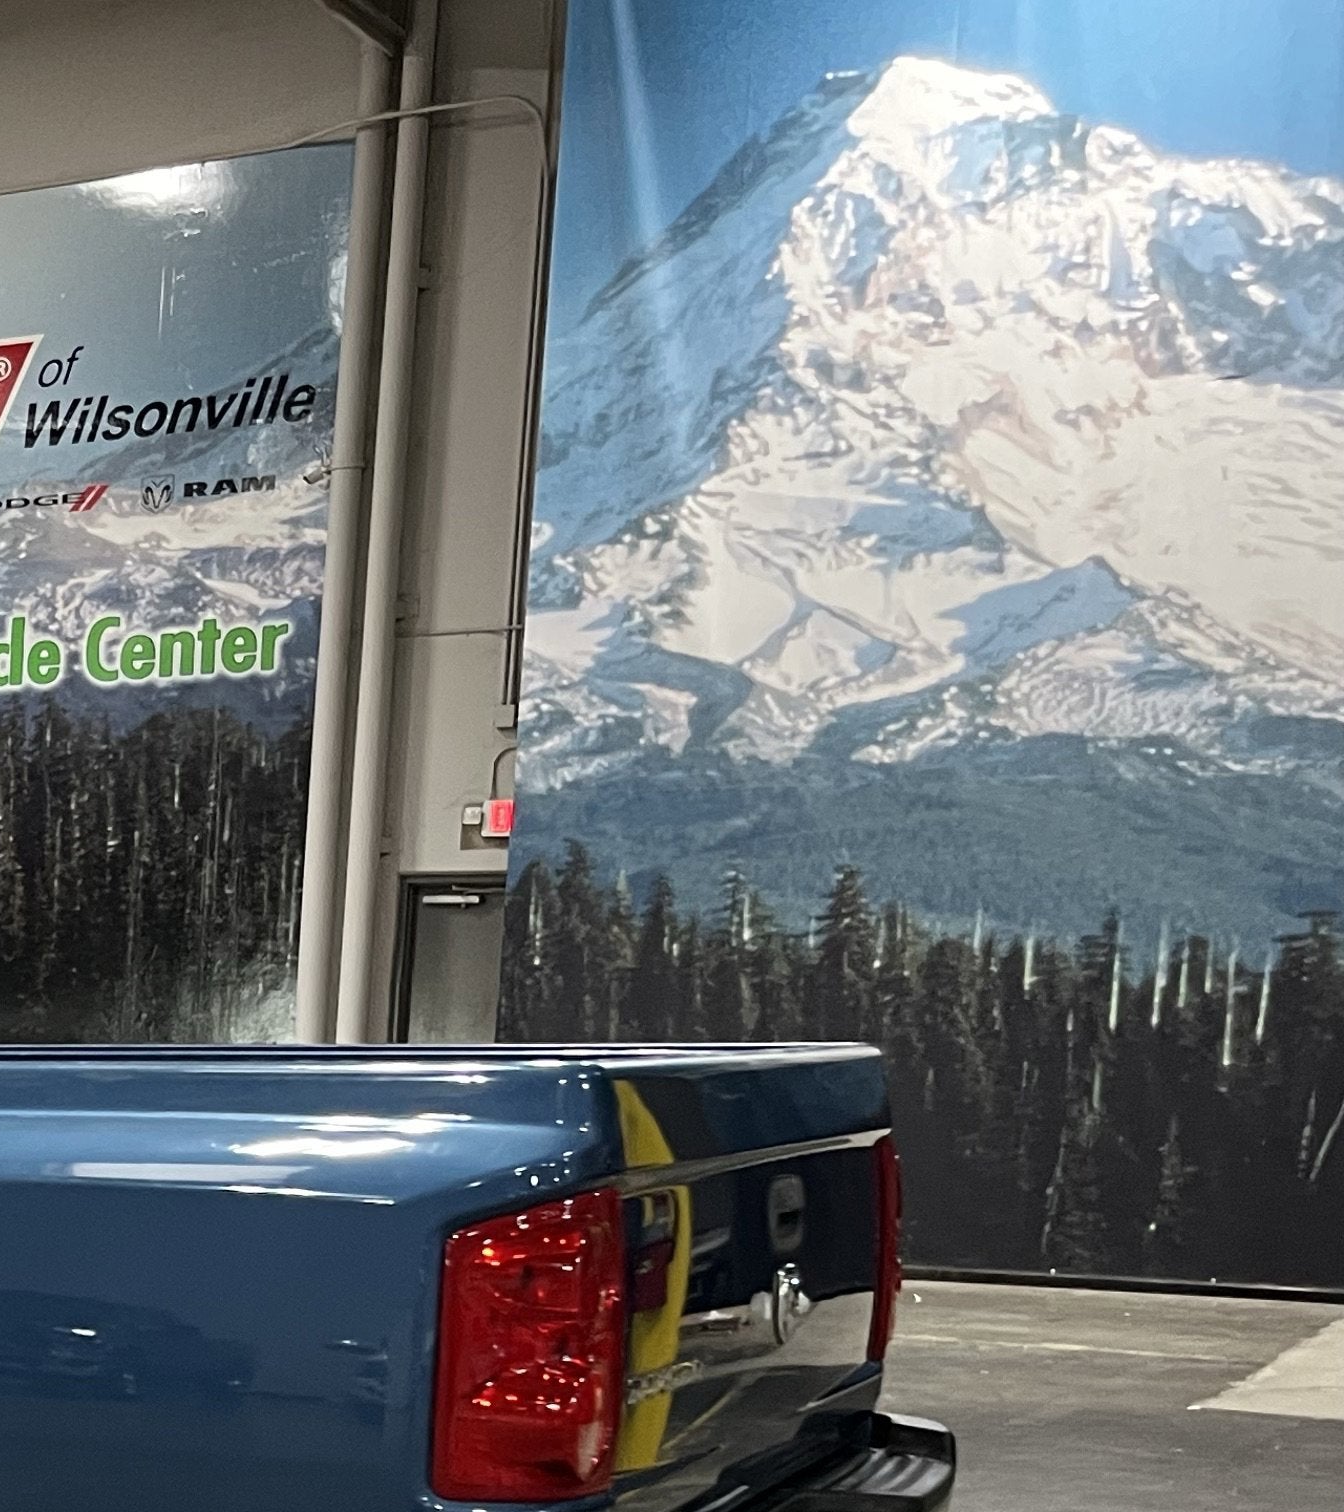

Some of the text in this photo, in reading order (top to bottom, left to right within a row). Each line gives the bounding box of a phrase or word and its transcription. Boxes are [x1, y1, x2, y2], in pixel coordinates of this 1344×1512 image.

[38, 346, 85, 388] of
[24, 374, 316, 449] Wilsonville
[183, 475, 277, 497] RAM
[86, 617, 289, 682] Center
